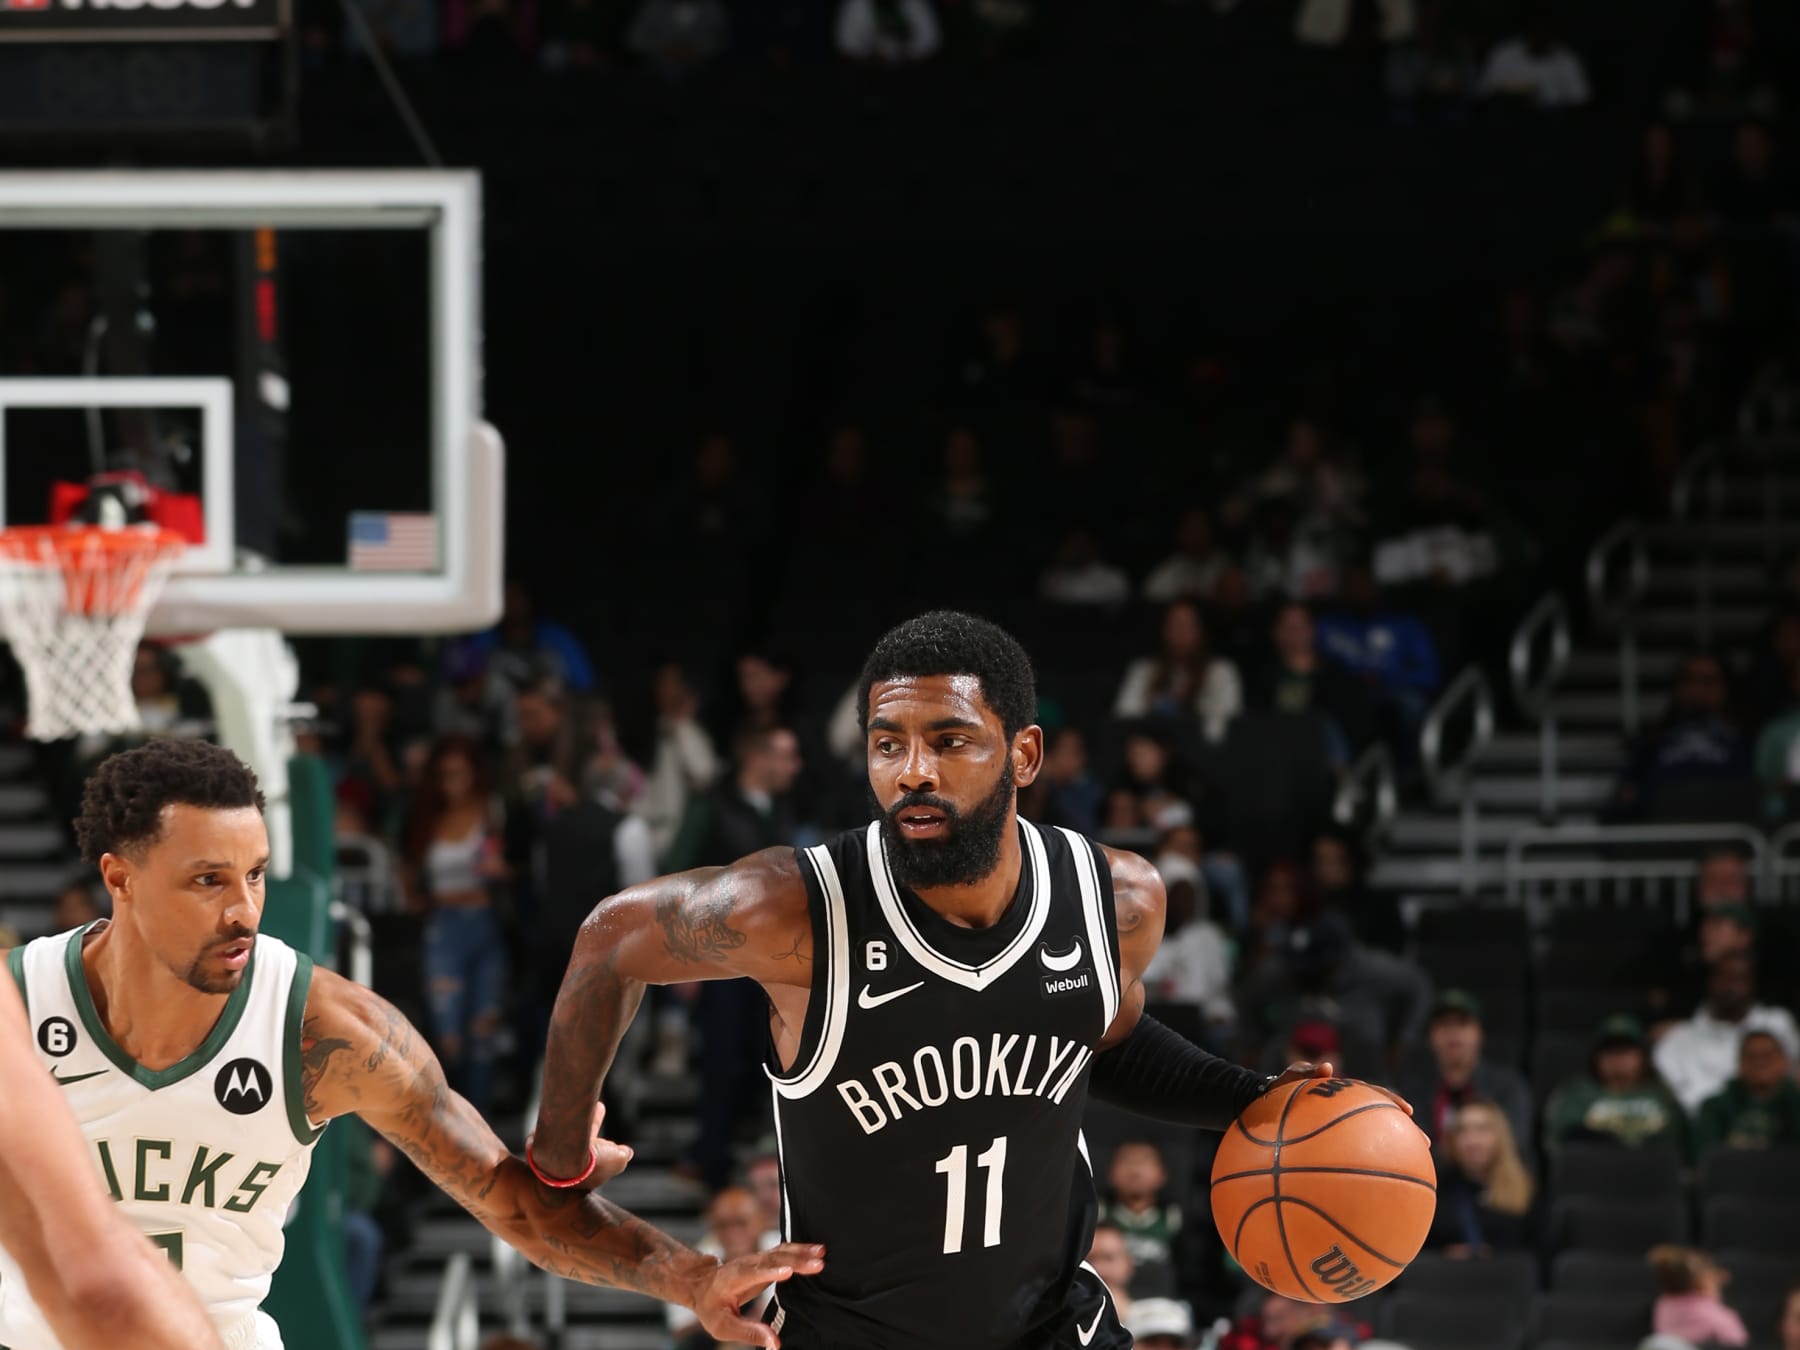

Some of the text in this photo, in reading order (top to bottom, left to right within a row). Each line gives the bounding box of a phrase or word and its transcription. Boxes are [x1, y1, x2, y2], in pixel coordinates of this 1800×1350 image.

[866, 940, 887, 971] 6
[1045, 974, 1089, 995] Webull
[47, 1022, 69, 1053] 6
[836, 1033, 1093, 1135] BROOKLYN
[97, 1136, 283, 1214] CKS
[936, 1136, 1007, 1254] 11
[1311, 1243, 1377, 1298] Wil
